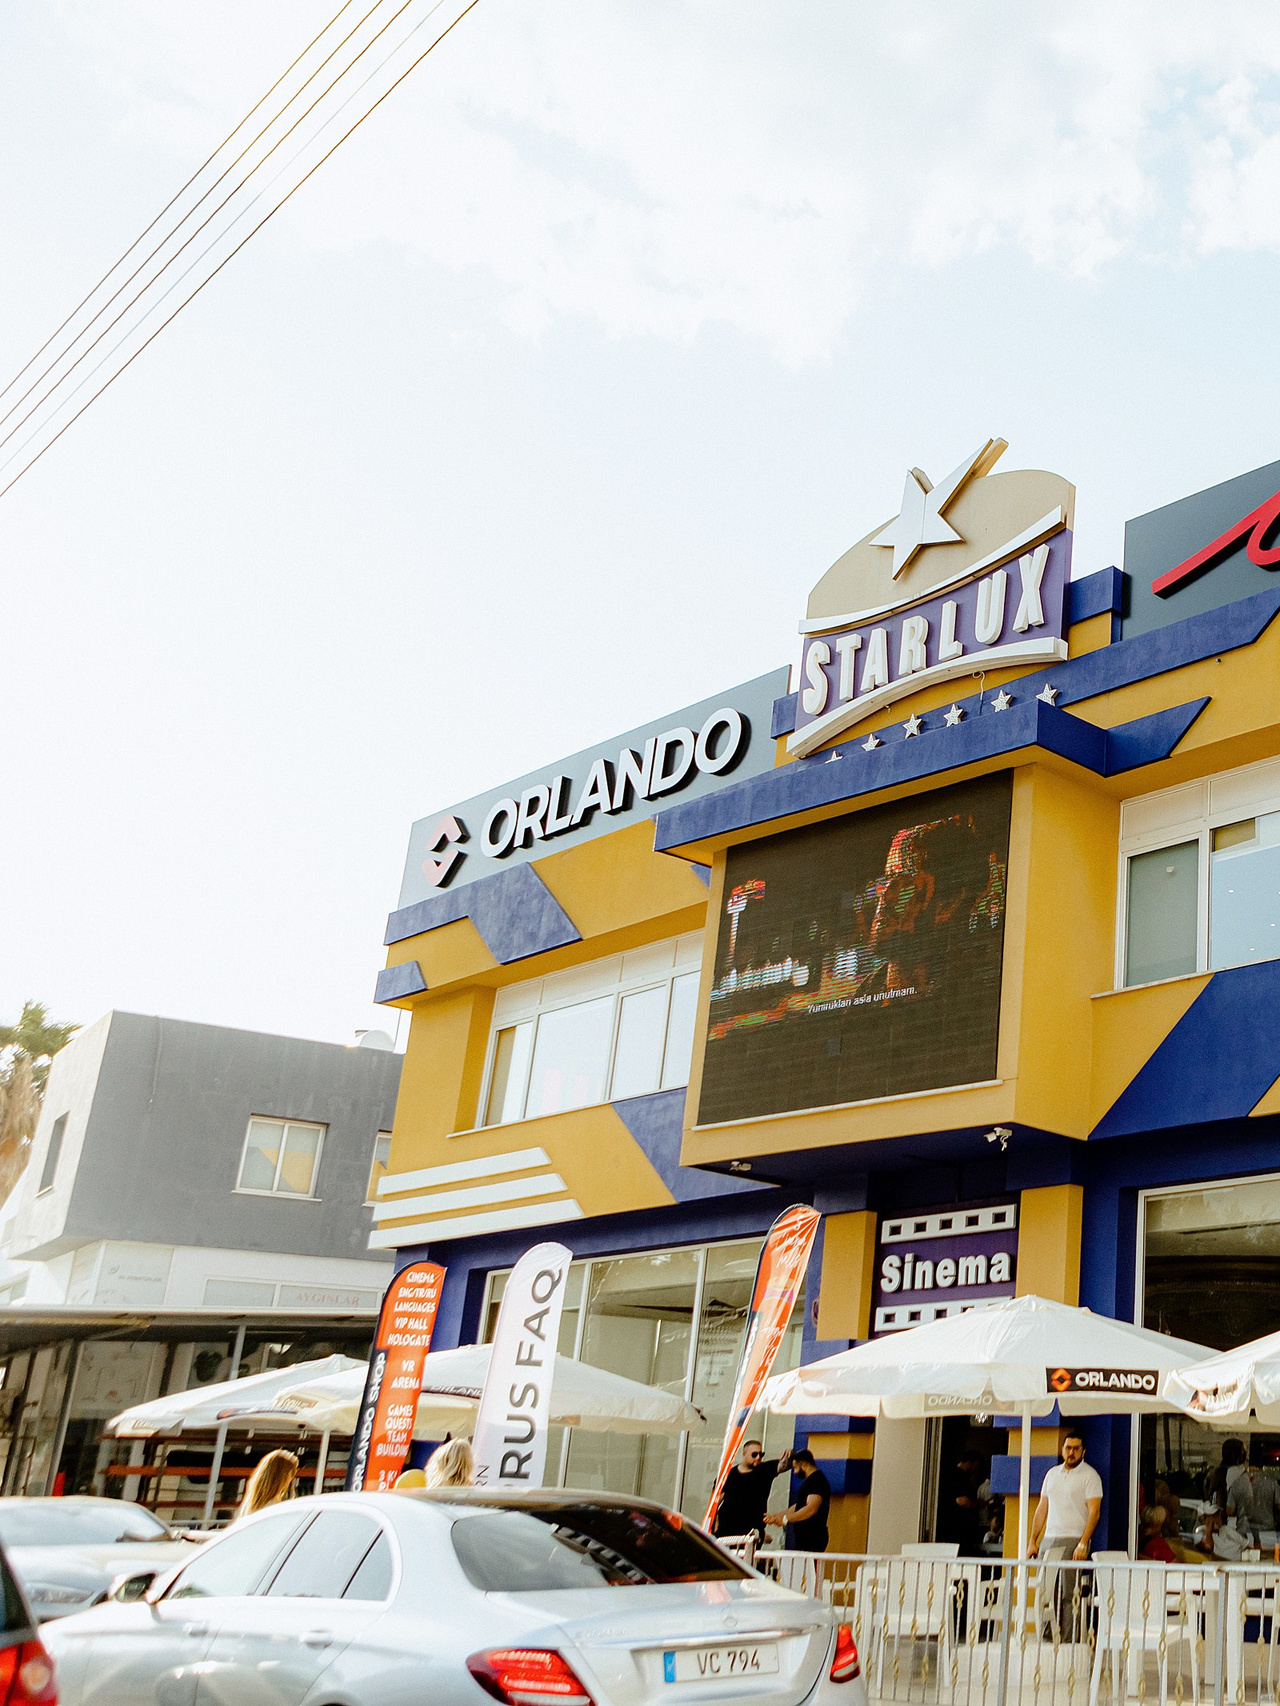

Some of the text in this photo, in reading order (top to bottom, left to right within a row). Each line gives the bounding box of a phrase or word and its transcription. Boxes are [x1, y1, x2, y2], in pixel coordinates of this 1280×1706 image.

[802, 543, 1051, 716] STARLUX
[480, 707, 746, 858] ORLANDO
[406, 1271, 435, 1283] CINEMA
[880, 1252, 1011, 1293] Sinema
[393, 1301, 436, 1313] LANGUAGES
[394, 1317, 428, 1330] VIP HALL
[387, 1333, 430, 1347] HOLOGATE
[401, 1360, 416, 1373] VR
[391, 1376, 420, 1389] ARENA
[498, 1268, 563, 1486] RUS FAQ
[1075, 1372, 1156, 1390] ORLANDO
[387, 1404, 414, 1417] GAMES
[352, 1352, 386, 1493] ORLANDO SHOP
[384, 1418, 413, 1430] QUESTS
[387, 1430, 408, 1442] TEAM
[696, 1648, 761, 1675] VC 794
